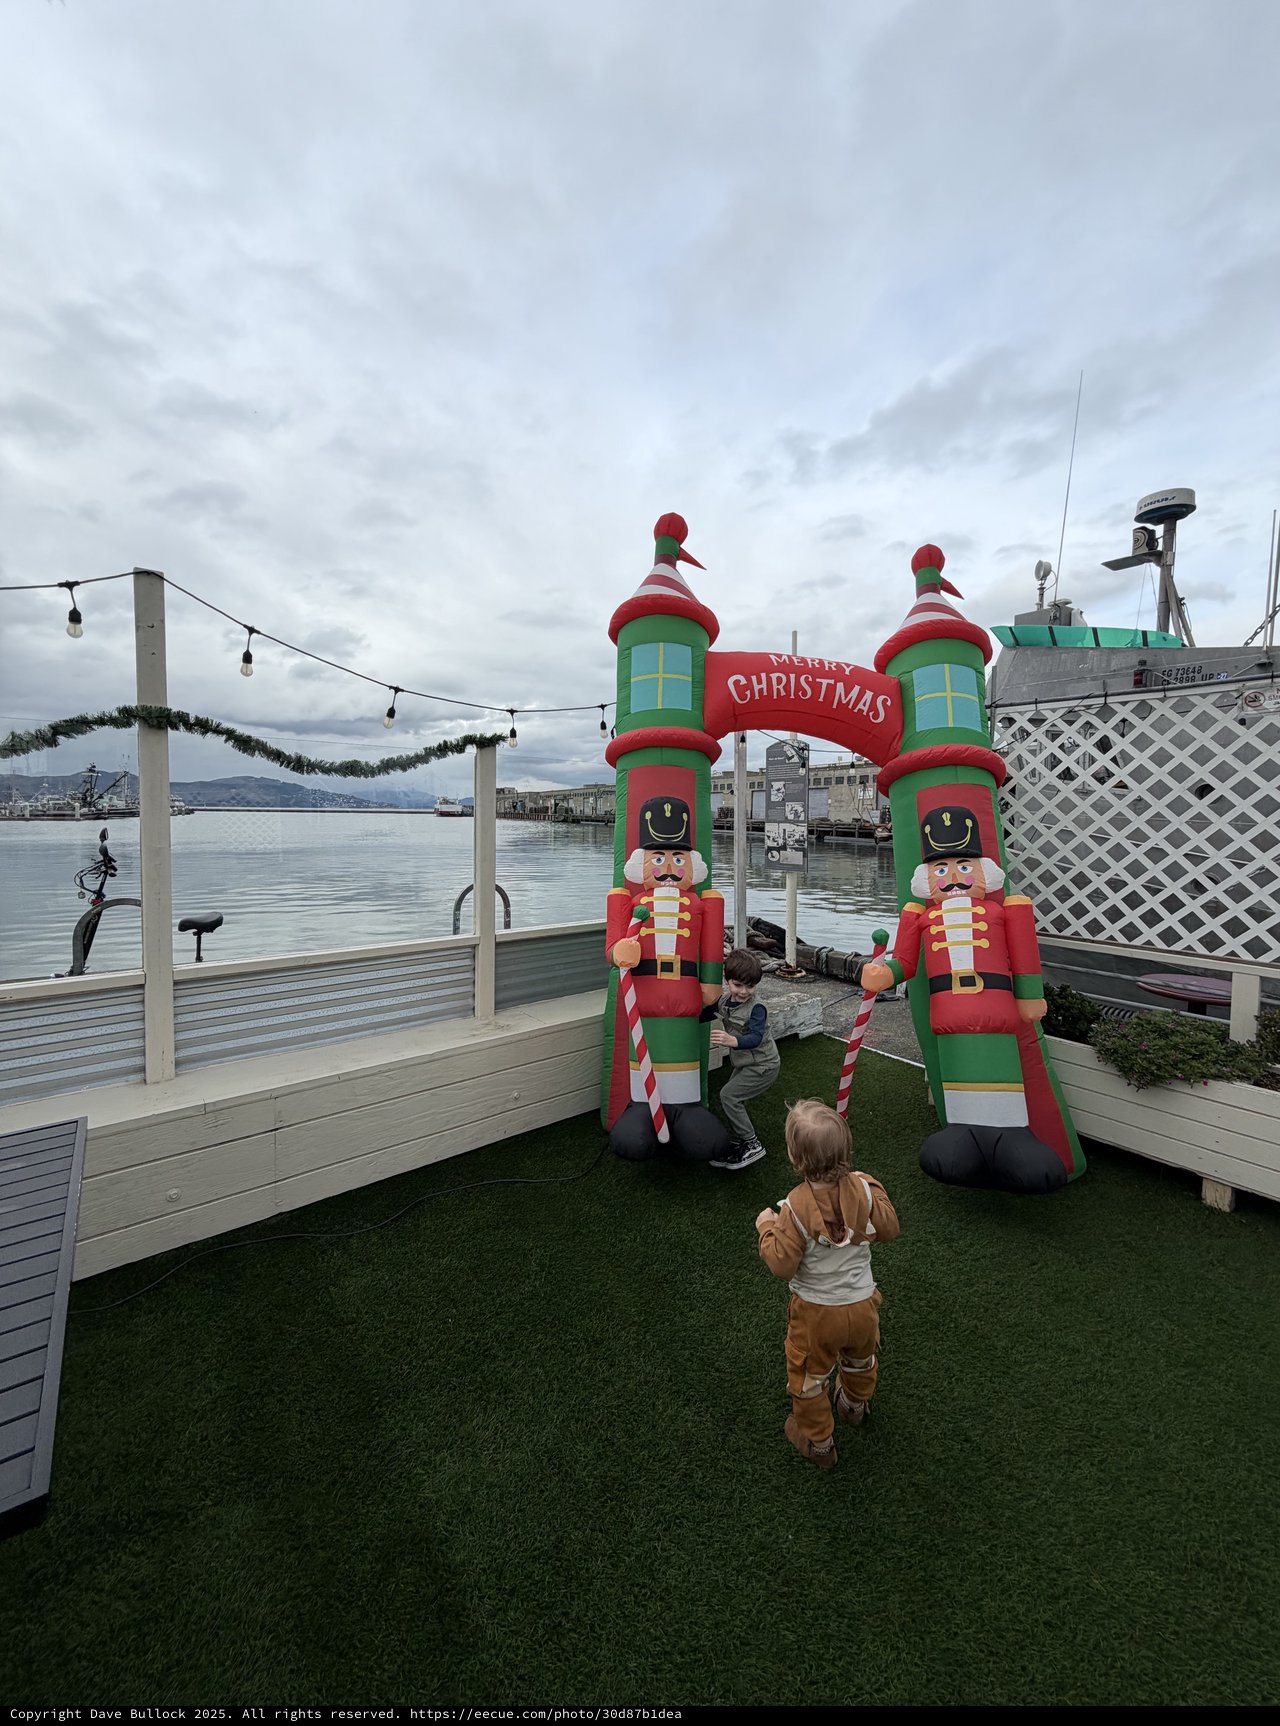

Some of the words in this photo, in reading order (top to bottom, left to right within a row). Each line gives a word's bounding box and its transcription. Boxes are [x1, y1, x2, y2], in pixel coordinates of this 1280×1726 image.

[769, 654, 855, 676] MERRY
[1175, 665, 1203, 677] 73648
[727, 672, 891, 724] CHRISTMAS
